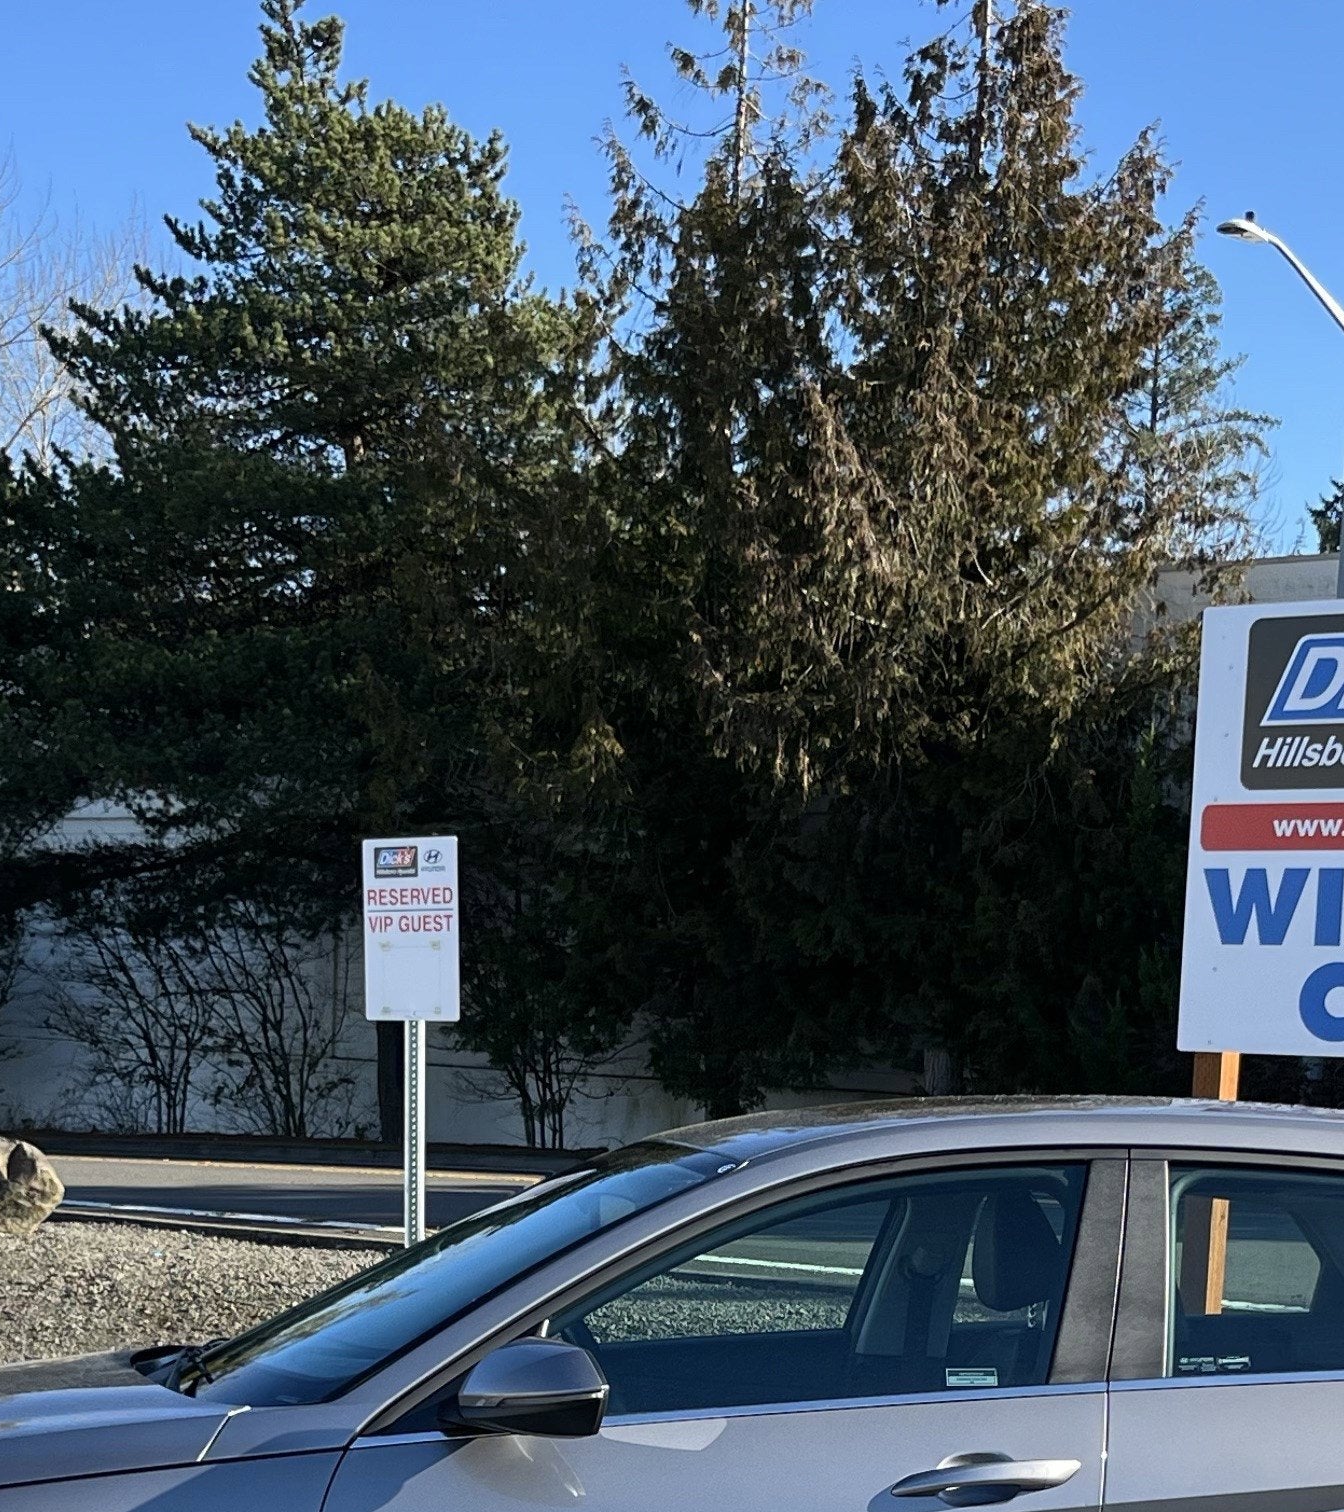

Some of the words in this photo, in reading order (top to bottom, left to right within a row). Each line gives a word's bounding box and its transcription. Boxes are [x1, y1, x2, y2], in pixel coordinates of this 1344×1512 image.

[367, 887, 453, 906] RESERVED
[369, 916, 393, 933] VIP
[398, 915, 453, 932] GUEST
